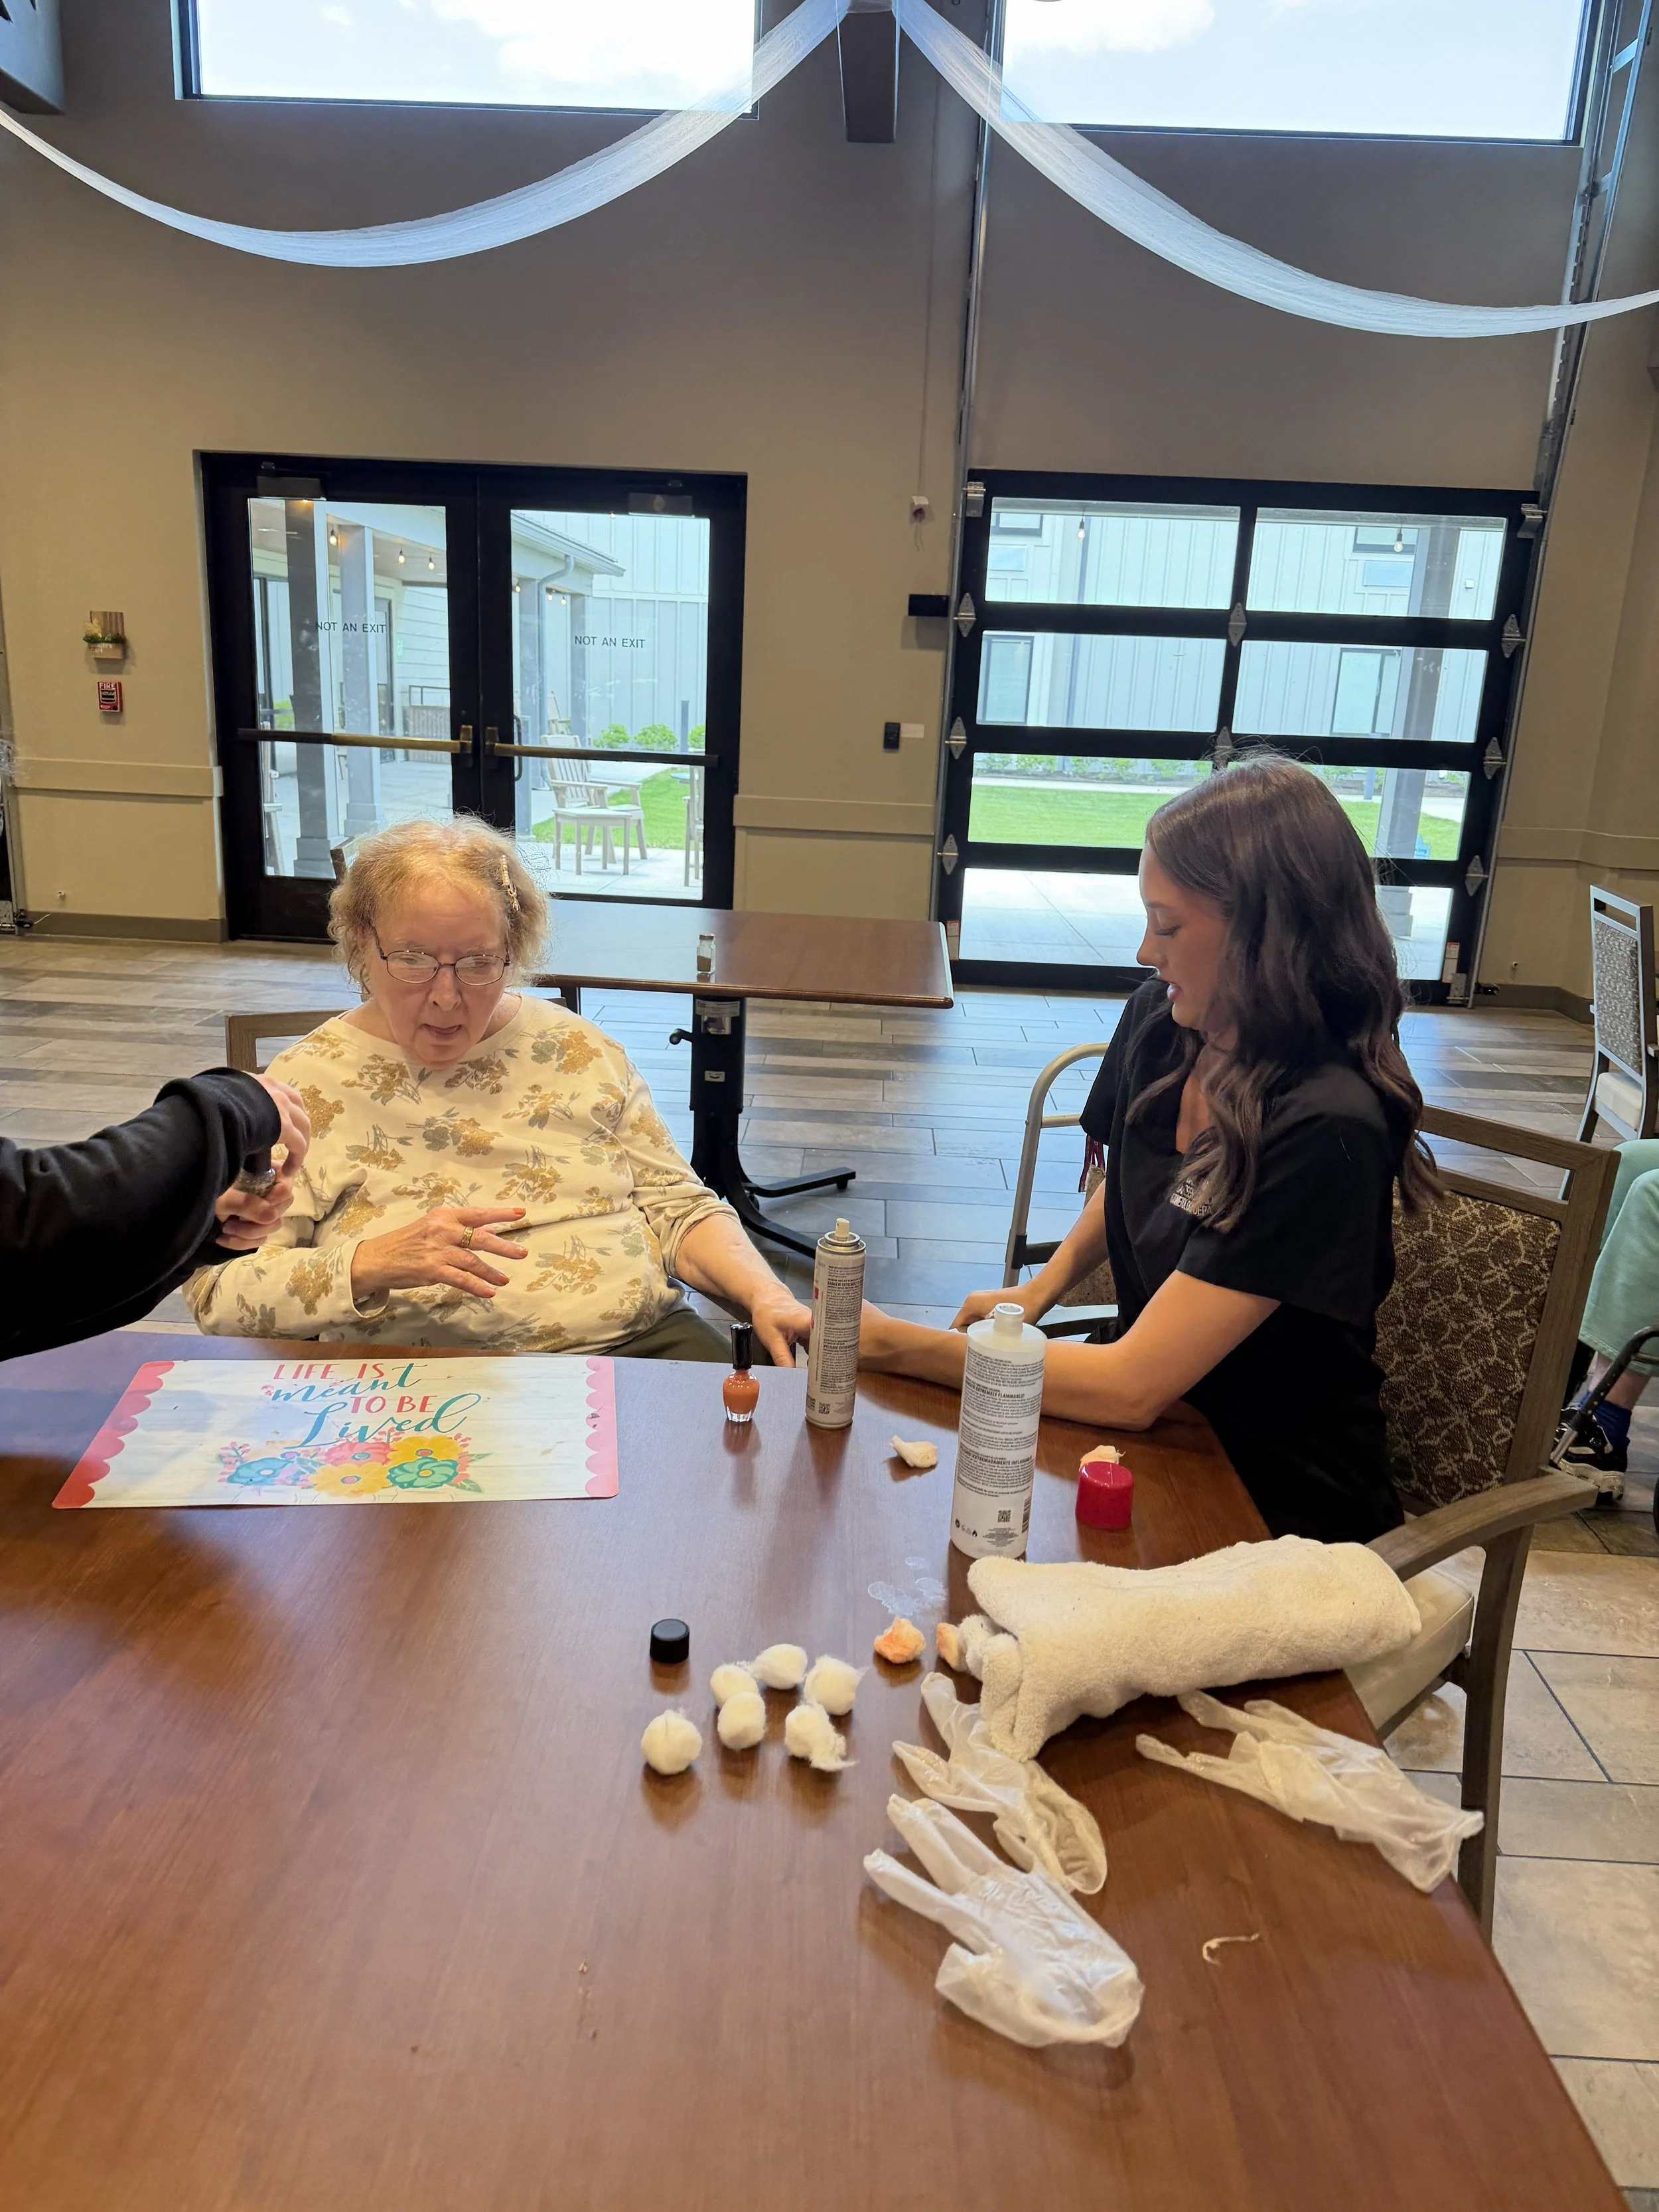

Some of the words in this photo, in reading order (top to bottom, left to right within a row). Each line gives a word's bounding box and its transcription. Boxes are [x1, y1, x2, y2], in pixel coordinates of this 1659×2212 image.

[316, 622, 337, 630] NOT
[342, 623, 357, 632] AN
[362, 624, 386, 633] EXIT
[575, 636, 597, 645] NOT
[602, 637, 616, 646] AN
[622, 638, 646, 648] EXIT
[273, 1364, 340, 1379] LIFE
[357, 1363, 385, 1379] IS
[271, 1363, 427, 1402] meant
[975, 1386, 997, 1397] EXTREMELY
[350, 1396, 386, 1414] TO
[396, 1396, 439, 1413] BE
[283, 1393, 482, 1449] Lived
